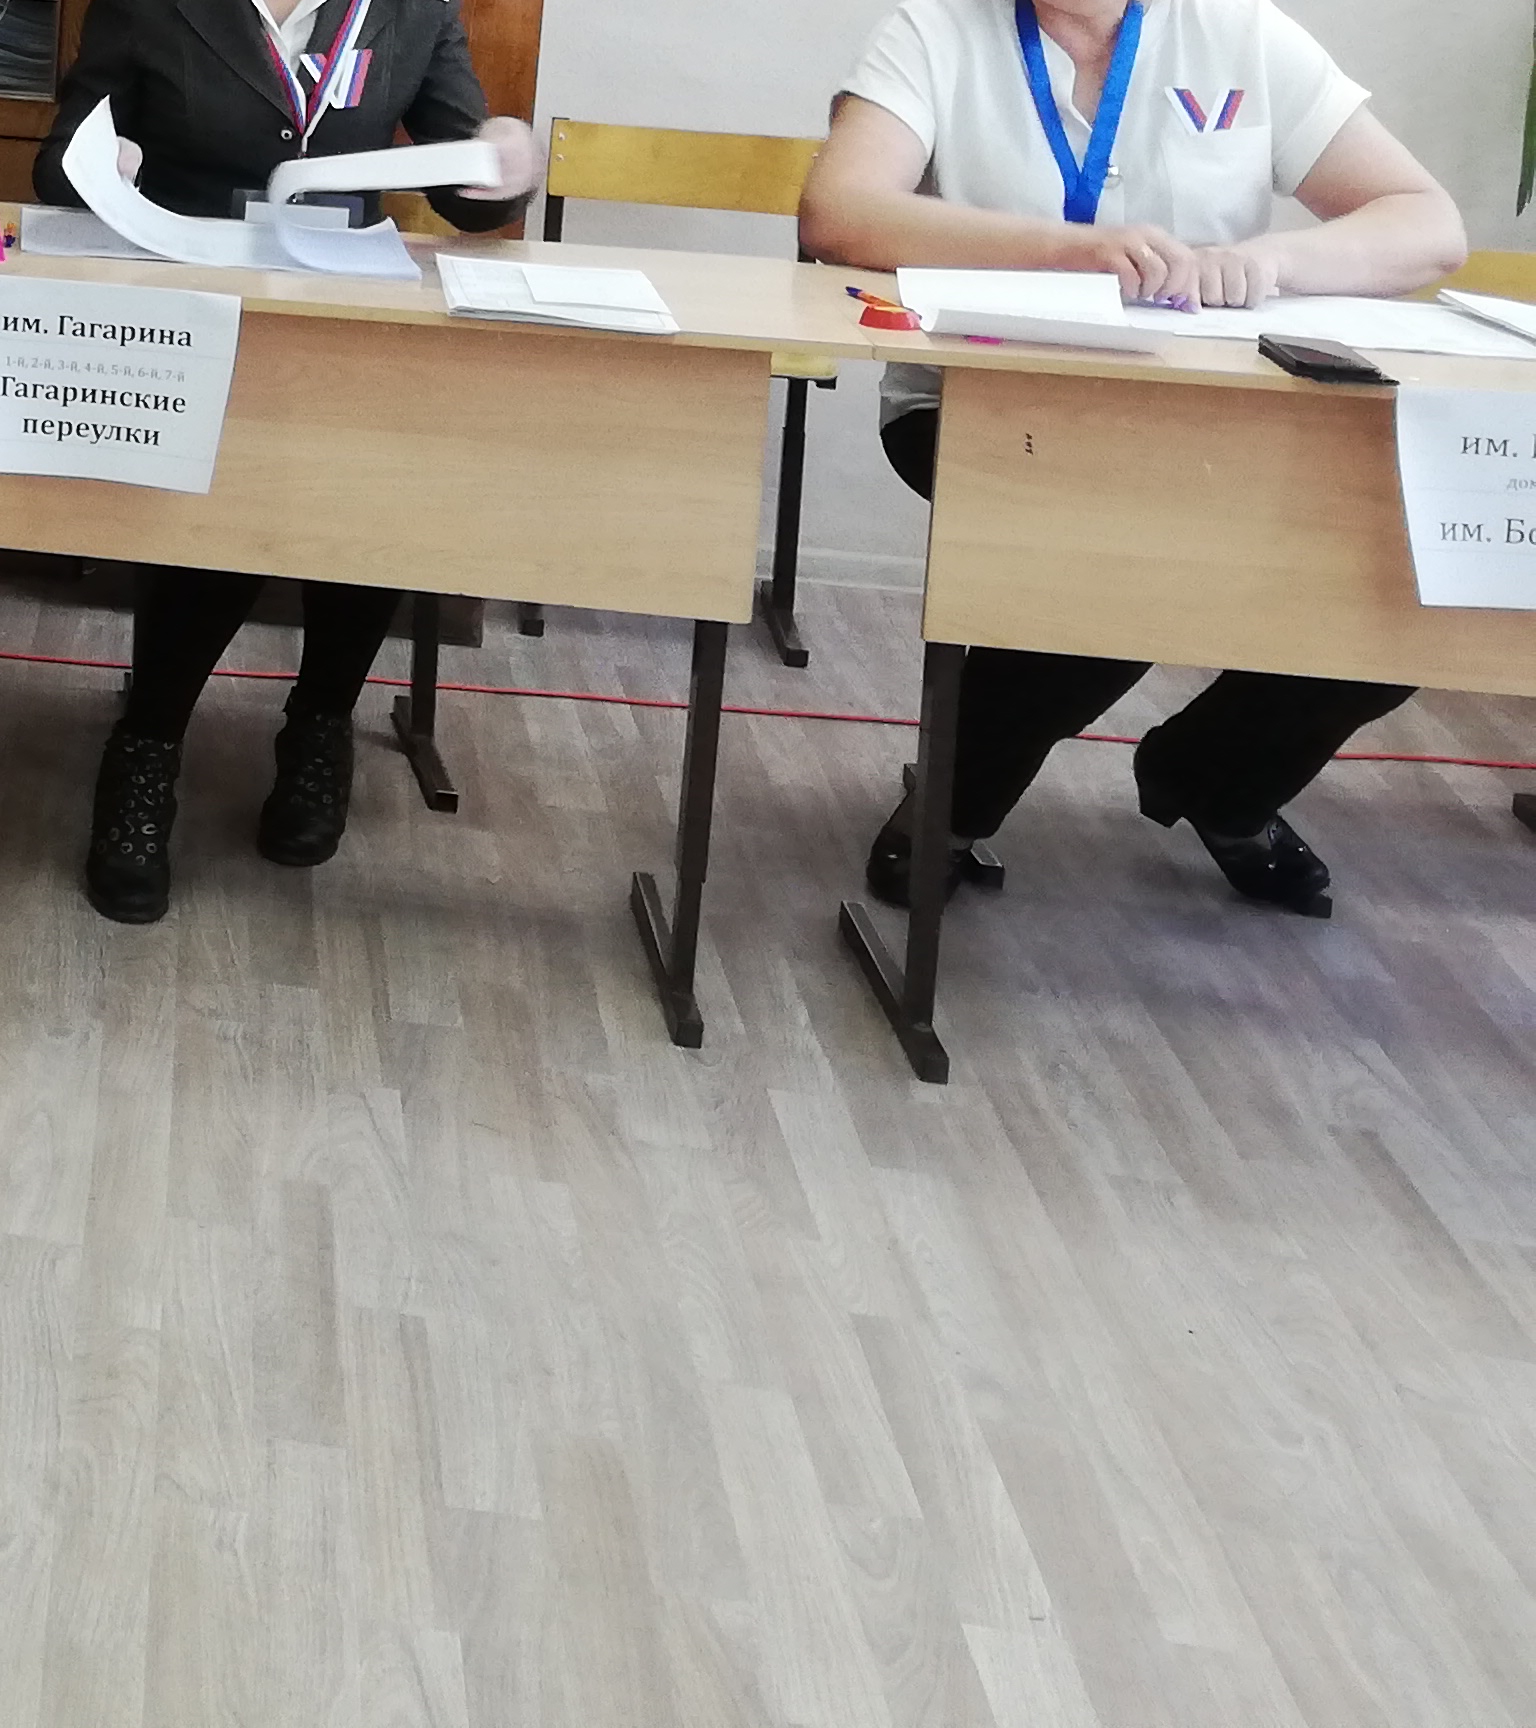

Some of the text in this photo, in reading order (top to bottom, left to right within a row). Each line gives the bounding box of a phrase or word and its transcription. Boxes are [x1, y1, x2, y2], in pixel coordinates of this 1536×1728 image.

[1, 314, 194, 348] им. Гагарина
[0, 375, 187, 414] Гагаринские
[21, 416, 162, 447] переулки
[1460, 435, 1518, 458] им.
[1439, 521, 1492, 543] им.
